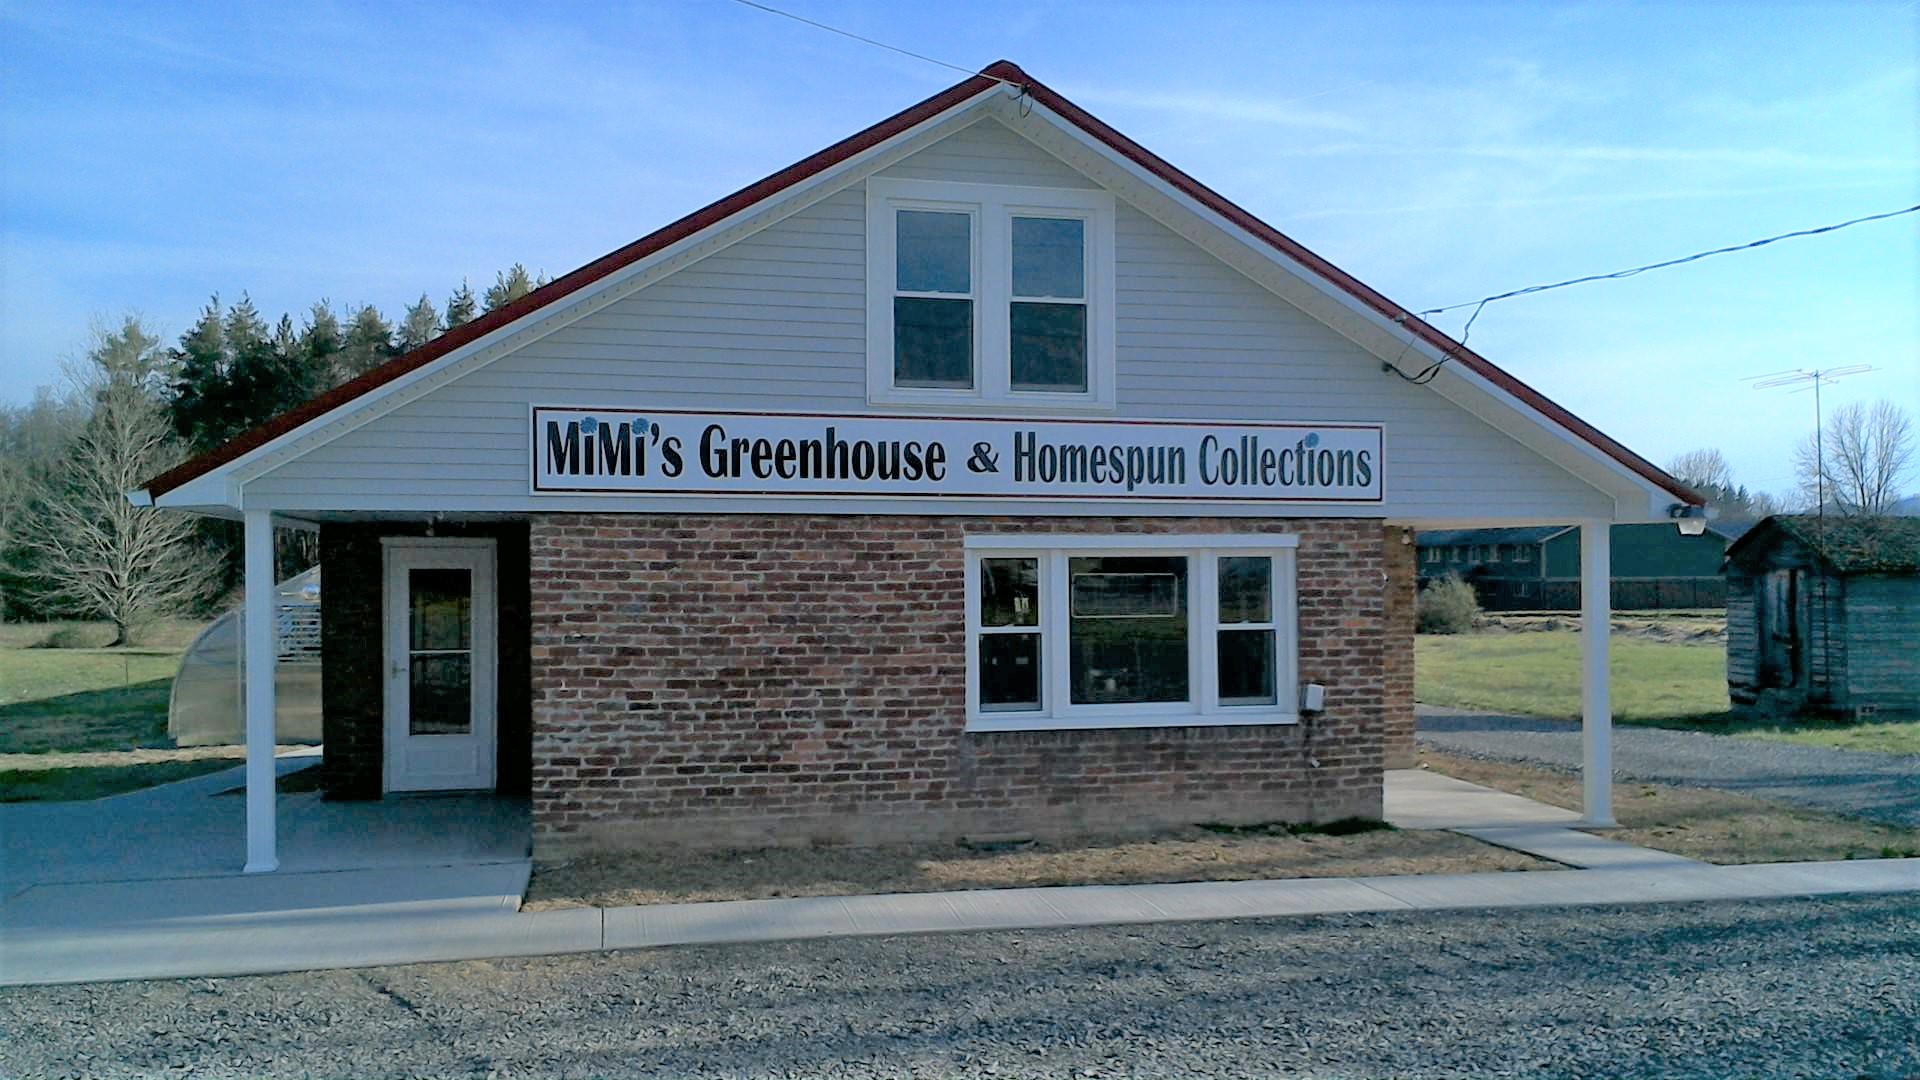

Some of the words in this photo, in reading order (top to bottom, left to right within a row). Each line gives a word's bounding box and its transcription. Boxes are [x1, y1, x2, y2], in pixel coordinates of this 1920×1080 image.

[699, 423, 947, 482] Greenhouse
[966, 441, 999, 474] &
[1013, 431, 1186, 492] Homespun
[1199, 432, 1372, 487] Collections
